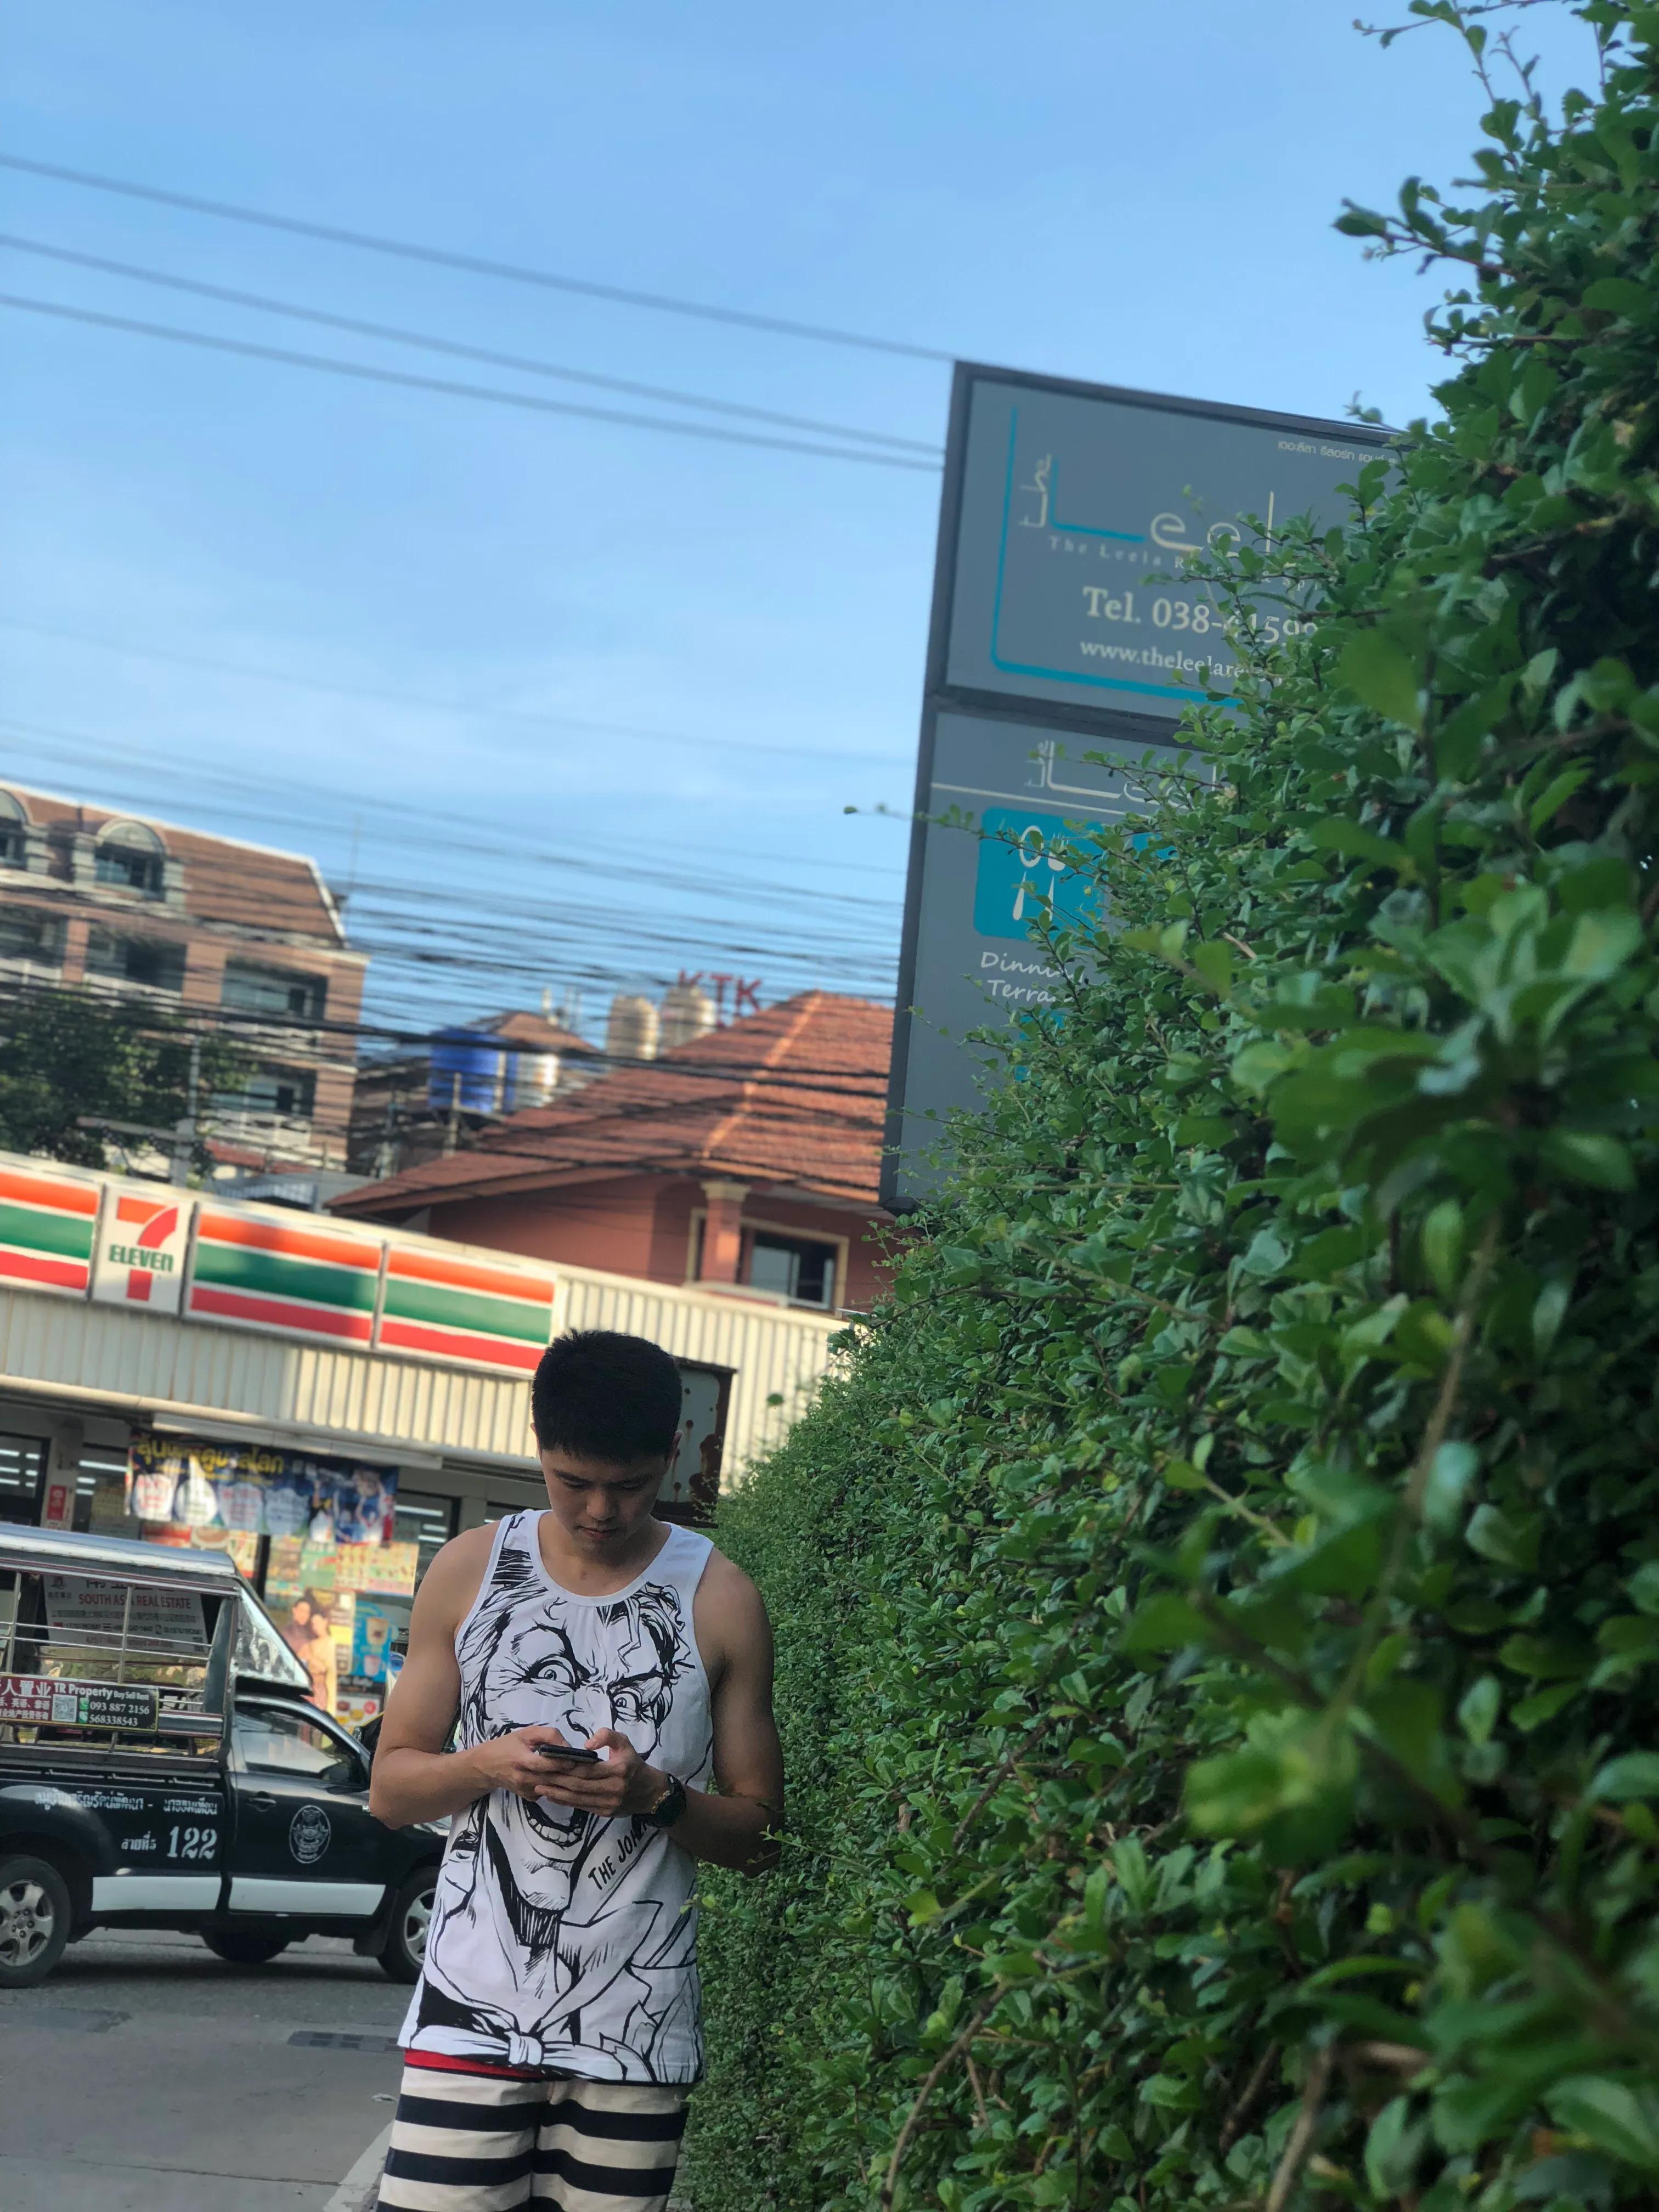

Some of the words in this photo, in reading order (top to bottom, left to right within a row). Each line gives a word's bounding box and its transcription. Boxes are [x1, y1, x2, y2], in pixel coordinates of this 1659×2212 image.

[1048, 456, 1296, 568] Leel
[1049, 534, 1087, 554] The
[1099, 543, 1162, 566] Leela
[1082, 585, 1142, 624] Tel.
[987, 979, 1075, 1003] Terra
[78, 1593, 110, 1605] SOUTH
[137, 1595, 159, 1607] REAL
[161, 1596, 191, 1609] ESTATE
[0, 1679, 52, 1699] 人置业
[54, 1682, 66, 1694] TR
[69, 1684, 115, 1700] Property
[126, 1691, 136, 1700] Sell
[137, 1692, 149, 1700] Rent
[90, 1701, 107, 1711] 093
[109, 1702, 126, 1712] 887
[128, 1705, 150, 1714] 2156
[89, 1714, 138, 1726] 568338543
[167, 1826, 218, 1859] 122
[588, 1855, 617, 1891] THE
